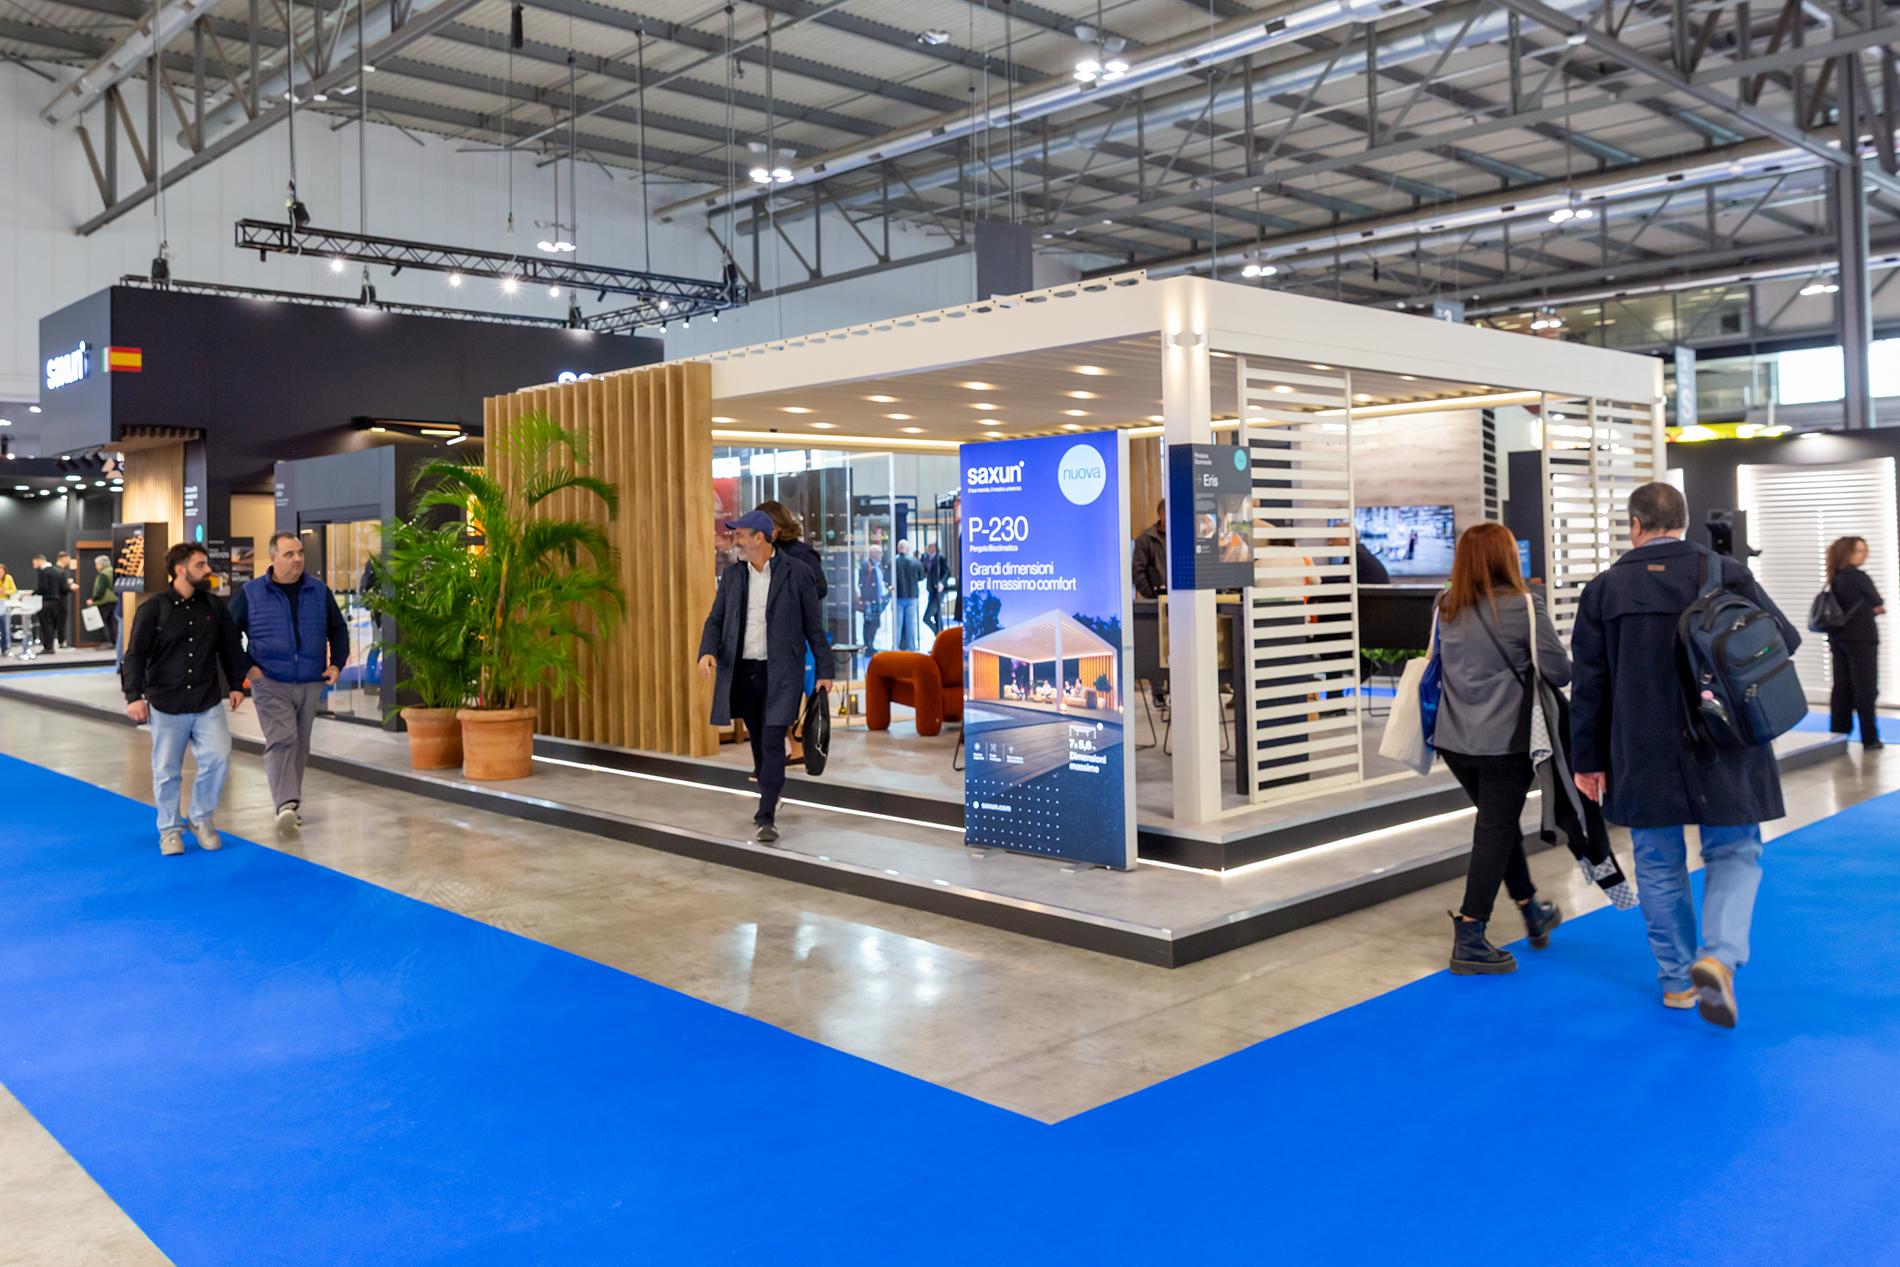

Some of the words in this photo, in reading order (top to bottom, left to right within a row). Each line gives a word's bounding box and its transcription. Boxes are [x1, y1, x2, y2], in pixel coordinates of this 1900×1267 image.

[968, 461, 1024, 485] saxun
[1063, 467, 1101, 480] nuova
[1203, 474, 1219, 487] Eris
[969, 516, 1029, 542] P-230
[970, 562, 1001, 576] Grandi
[1002, 561, 1054, 575] dimensioni
[970, 580, 986, 593] per
[986, 578, 992, 590] il
[992, 577, 1036, 590] massimo
[1037, 577, 1077, 590] comfort
